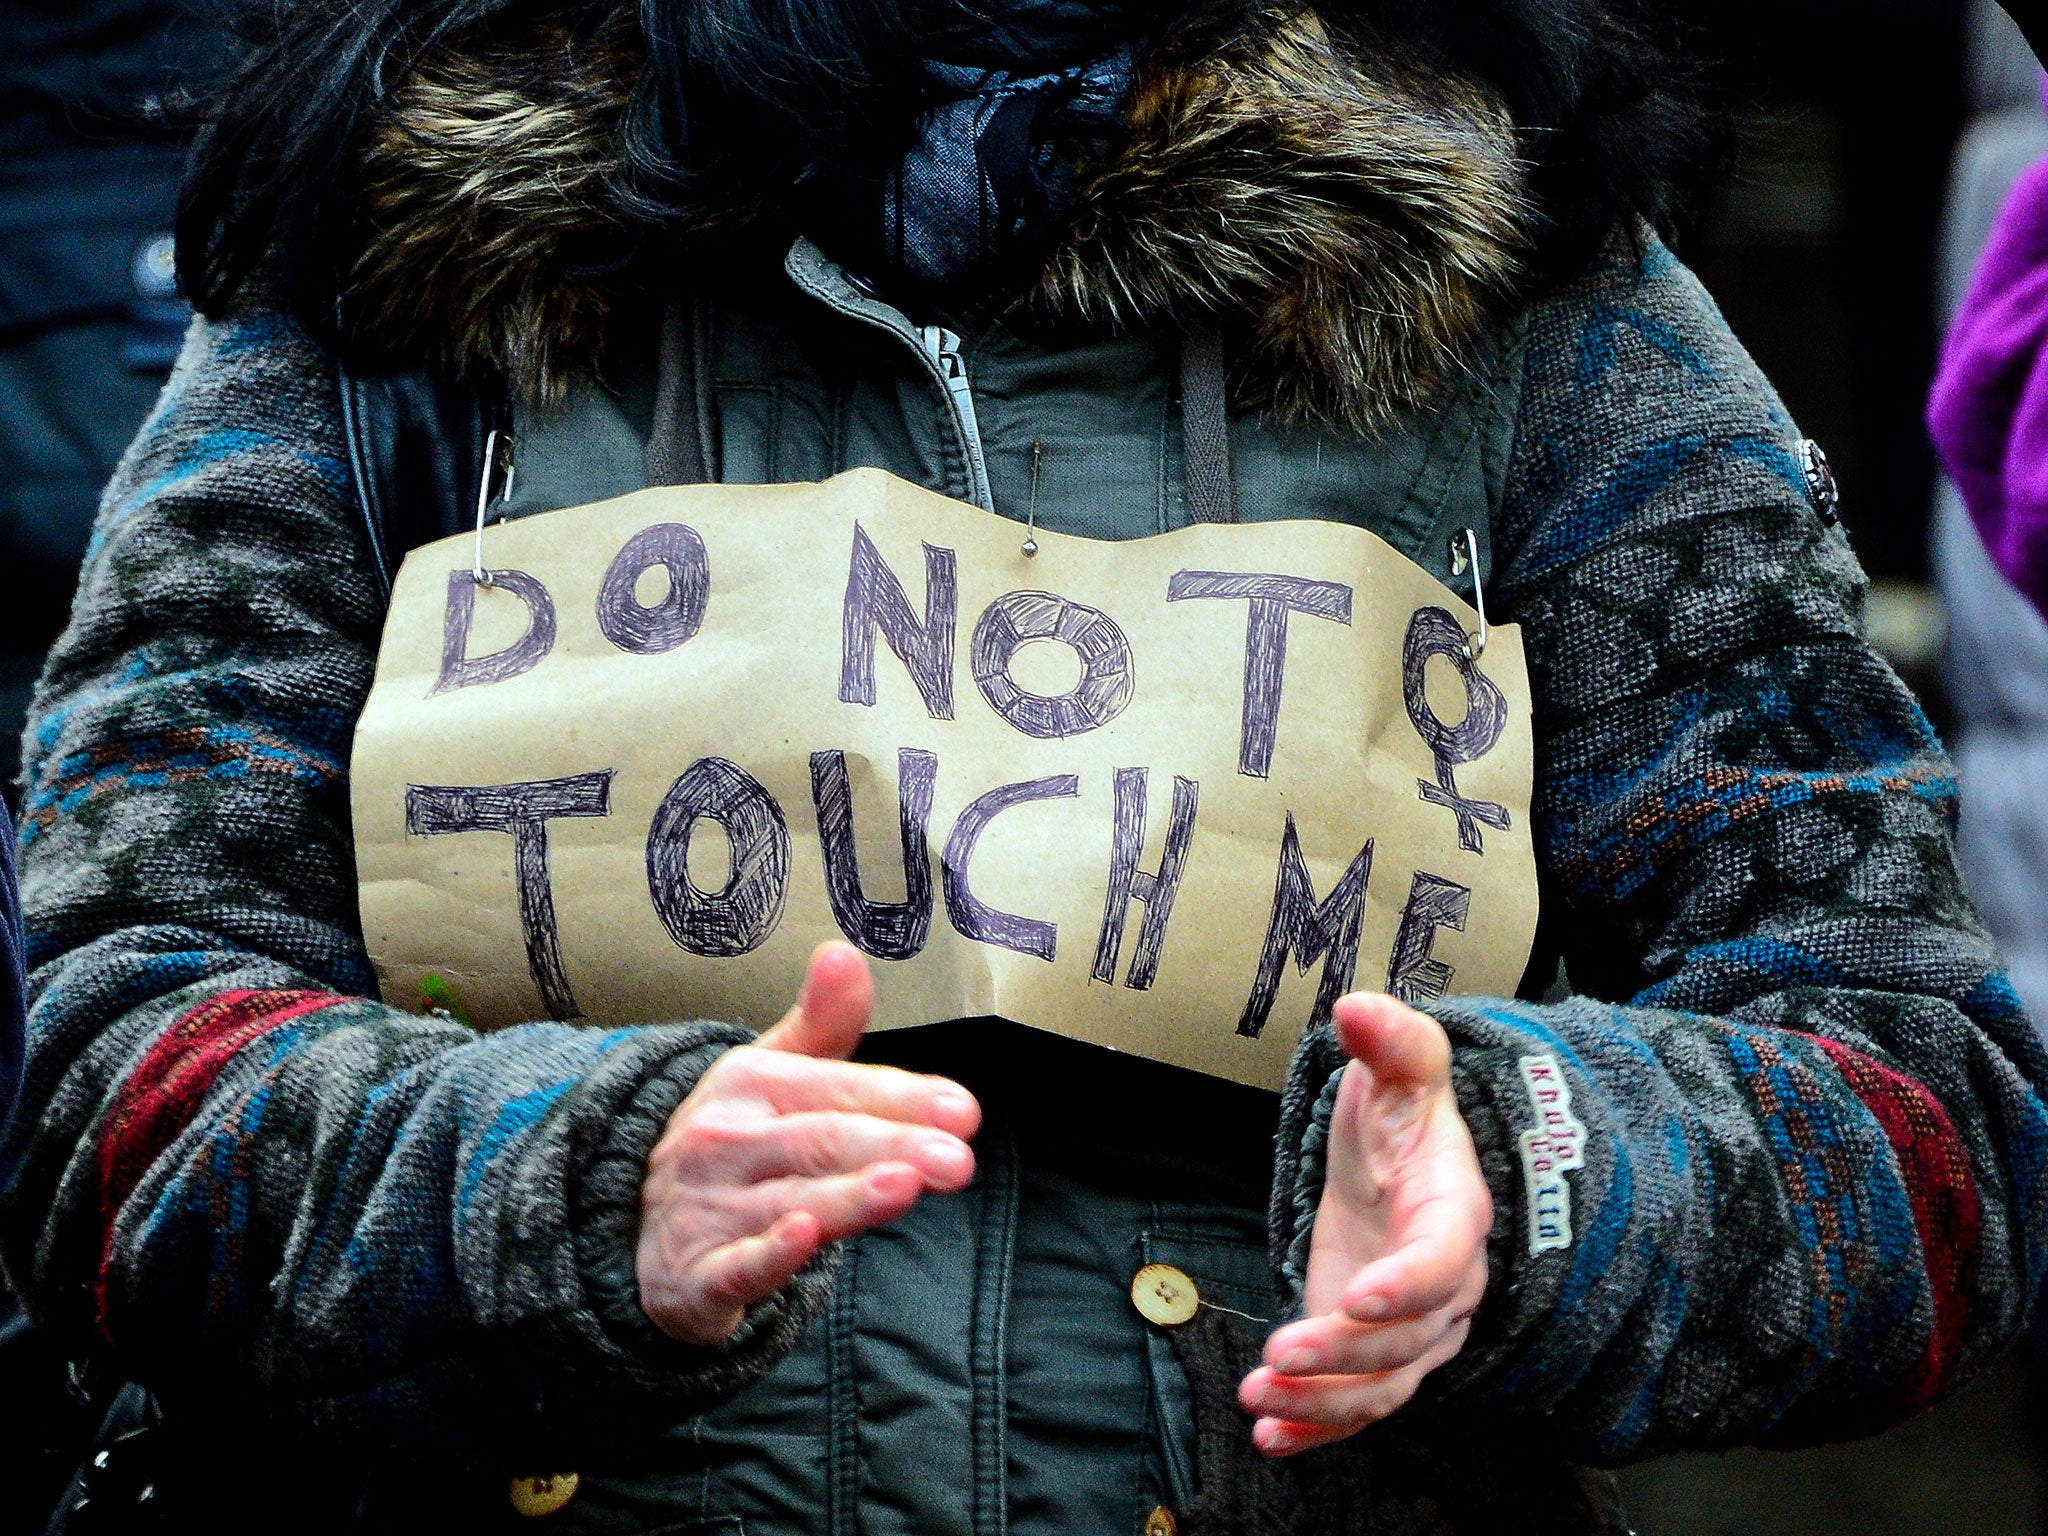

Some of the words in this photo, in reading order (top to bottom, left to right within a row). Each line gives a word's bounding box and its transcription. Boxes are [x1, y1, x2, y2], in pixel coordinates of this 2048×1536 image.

[425, 522, 711, 698] DO
[838, 519, 1353, 780] NOT
[405, 747, 1199, 1019] TOUCH
[1235, 809, 1472, 1039] ME
